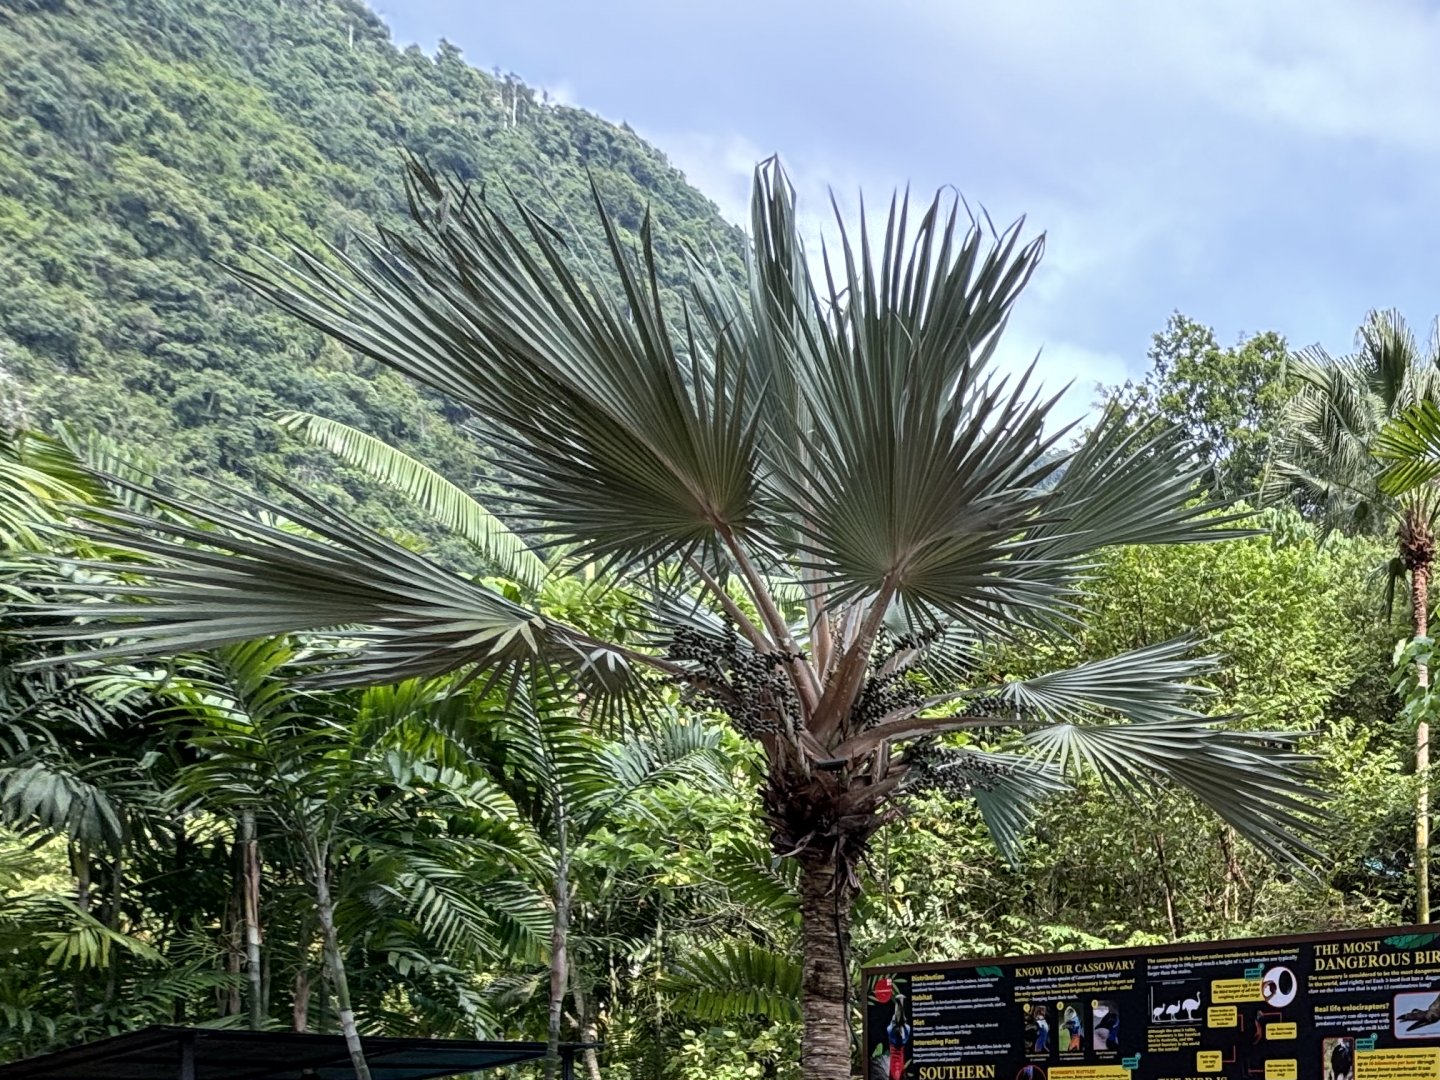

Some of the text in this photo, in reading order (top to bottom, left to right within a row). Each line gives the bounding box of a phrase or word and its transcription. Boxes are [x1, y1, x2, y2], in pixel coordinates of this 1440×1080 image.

[1314, 941, 1380, 956] THE MOST
[1015, 960, 1135, 977] KNOW YOUR CASSOWARY
[1315, 952, 1410, 971] DANGEROUS
[1342, 1003, 1389, 1011] velociraptors?
[919, 1065, 995, 1080] SOUTHERN
